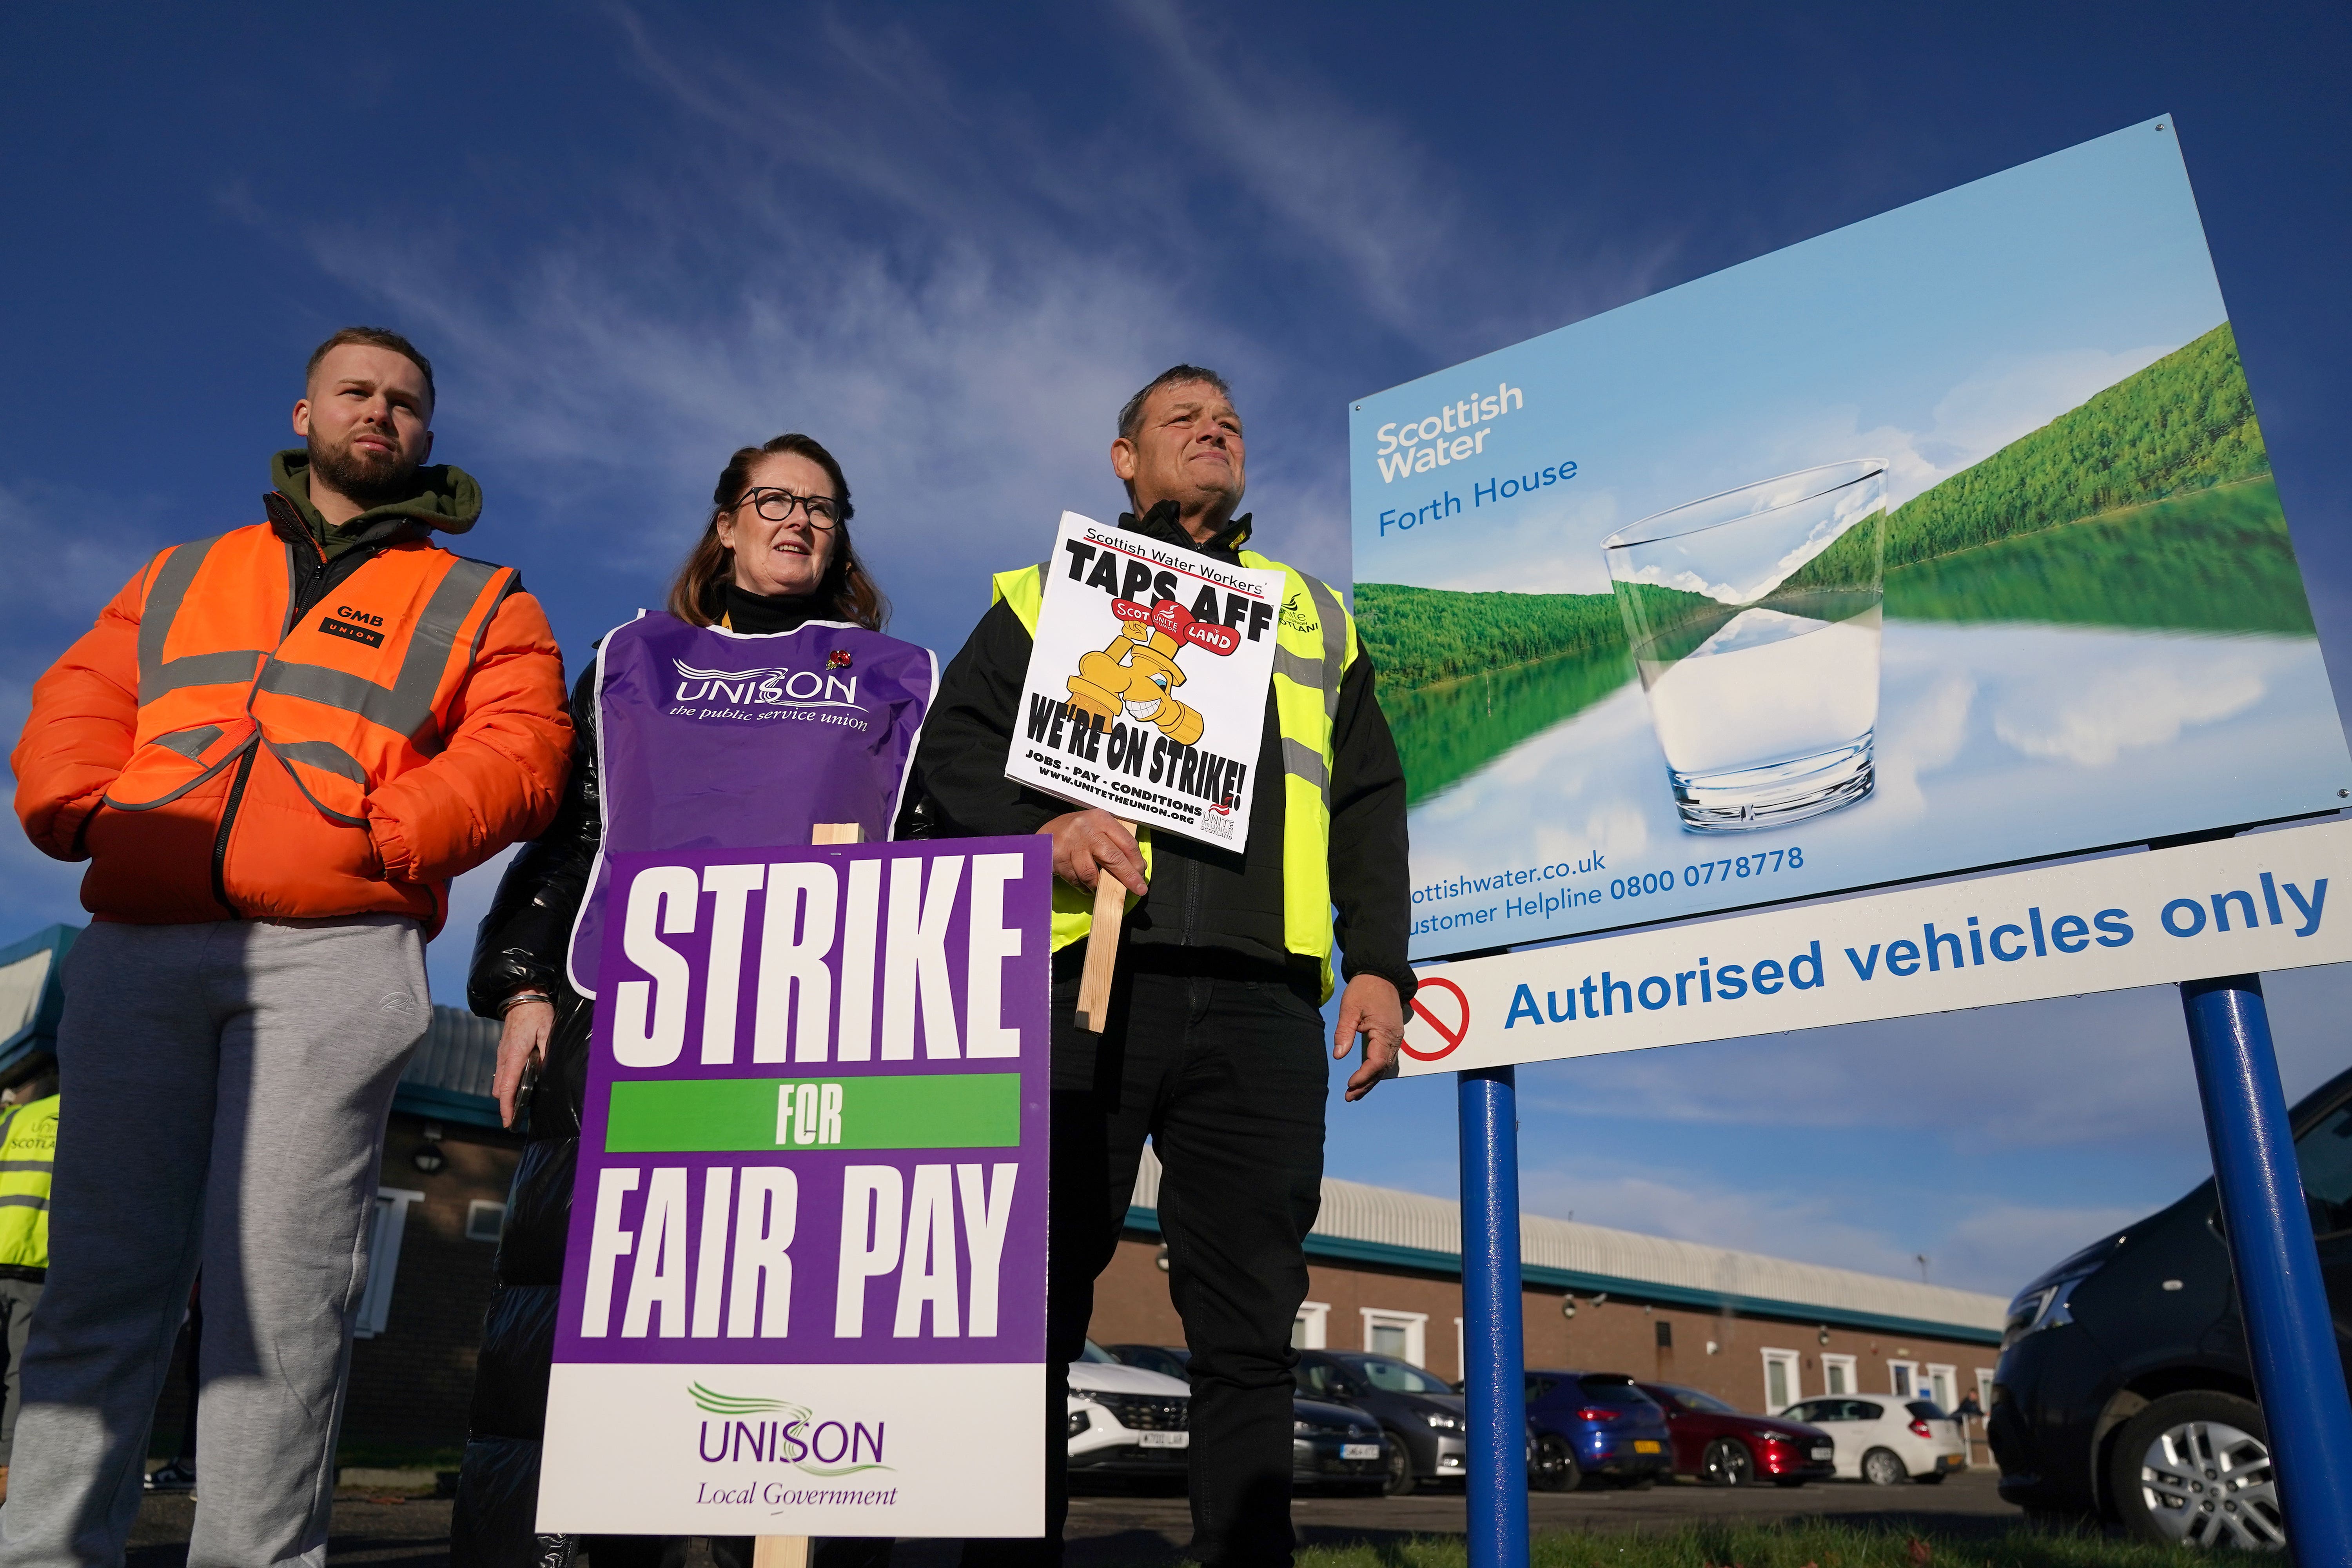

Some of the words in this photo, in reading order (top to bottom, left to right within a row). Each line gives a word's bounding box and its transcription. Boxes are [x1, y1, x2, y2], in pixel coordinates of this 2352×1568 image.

[1377, 383, 1523, 455] Scottish
[1377, 428, 1490, 484] Water
[1380, 491, 1461, 537] Forth
[1475, 461, 1578, 507] House
[1086, 528, 1145, 557] Scottish
[1152, 549, 1196, 572] Water
[1195, 564, 1267, 595] Workers'
[338, 606, 383, 626] GMB
[1066, 539, 1178, 609] TAPS
[1190, 584, 1274, 642] AFF
[1117, 603, 1150, 621] SCOT
[330, 624, 374, 641] UNION
[1154, 615, 1178, 629] UNITE
[1159, 622, 1177, 633] UNION
[1188, 626, 1231, 649] LAND
[676, 671, 857, 704] UNISON
[670, 706, 696, 716] the
[699, 708, 753, 720] public
[757, 707, 815, 720] service
[820, 713, 868, 732] union
[1027, 692, 1107, 763] WE'RE
[1107, 722, 1149, 778] ON
[1149, 736, 1247, 811] STRIKE!
[1025, 749, 1061, 769] JOBS
[1073, 766, 1101, 784] PAY
[1111, 781, 1202, 816] CONDITIONS
[1039, 766, 1194, 825] WWW.UNITETHEUNION.ORG
[1200, 826, 1232, 840] SCOTLAND
[1203, 811, 1234, 830] UNITE
[1210, 824, 1233, 836] UNION
[1410, 907, 1497, 935] ustomer
[1506, 888, 1602, 919] Helpline
[1610, 870, 1674, 900] 0800
[1684, 847, 1804, 887] 0778778
[1412, 850, 1606, 904] ottishwater.co.uk
[612, 853, 1024, 1067] STRIKE
[1504, 940, 1824, 1029] Authorised
[1844, 907, 2134, 981] vehicles
[2160, 872, 2328, 938] only
[775, 1083, 843, 1145] FOR
[580, 1166, 799, 1338] FAIR
[834, 1163, 1019, 1338] PAY
[699, 1421, 884, 1463] UNISON
[696, 1481, 757, 1505] Local
[763, 1482, 898, 1505] Government
